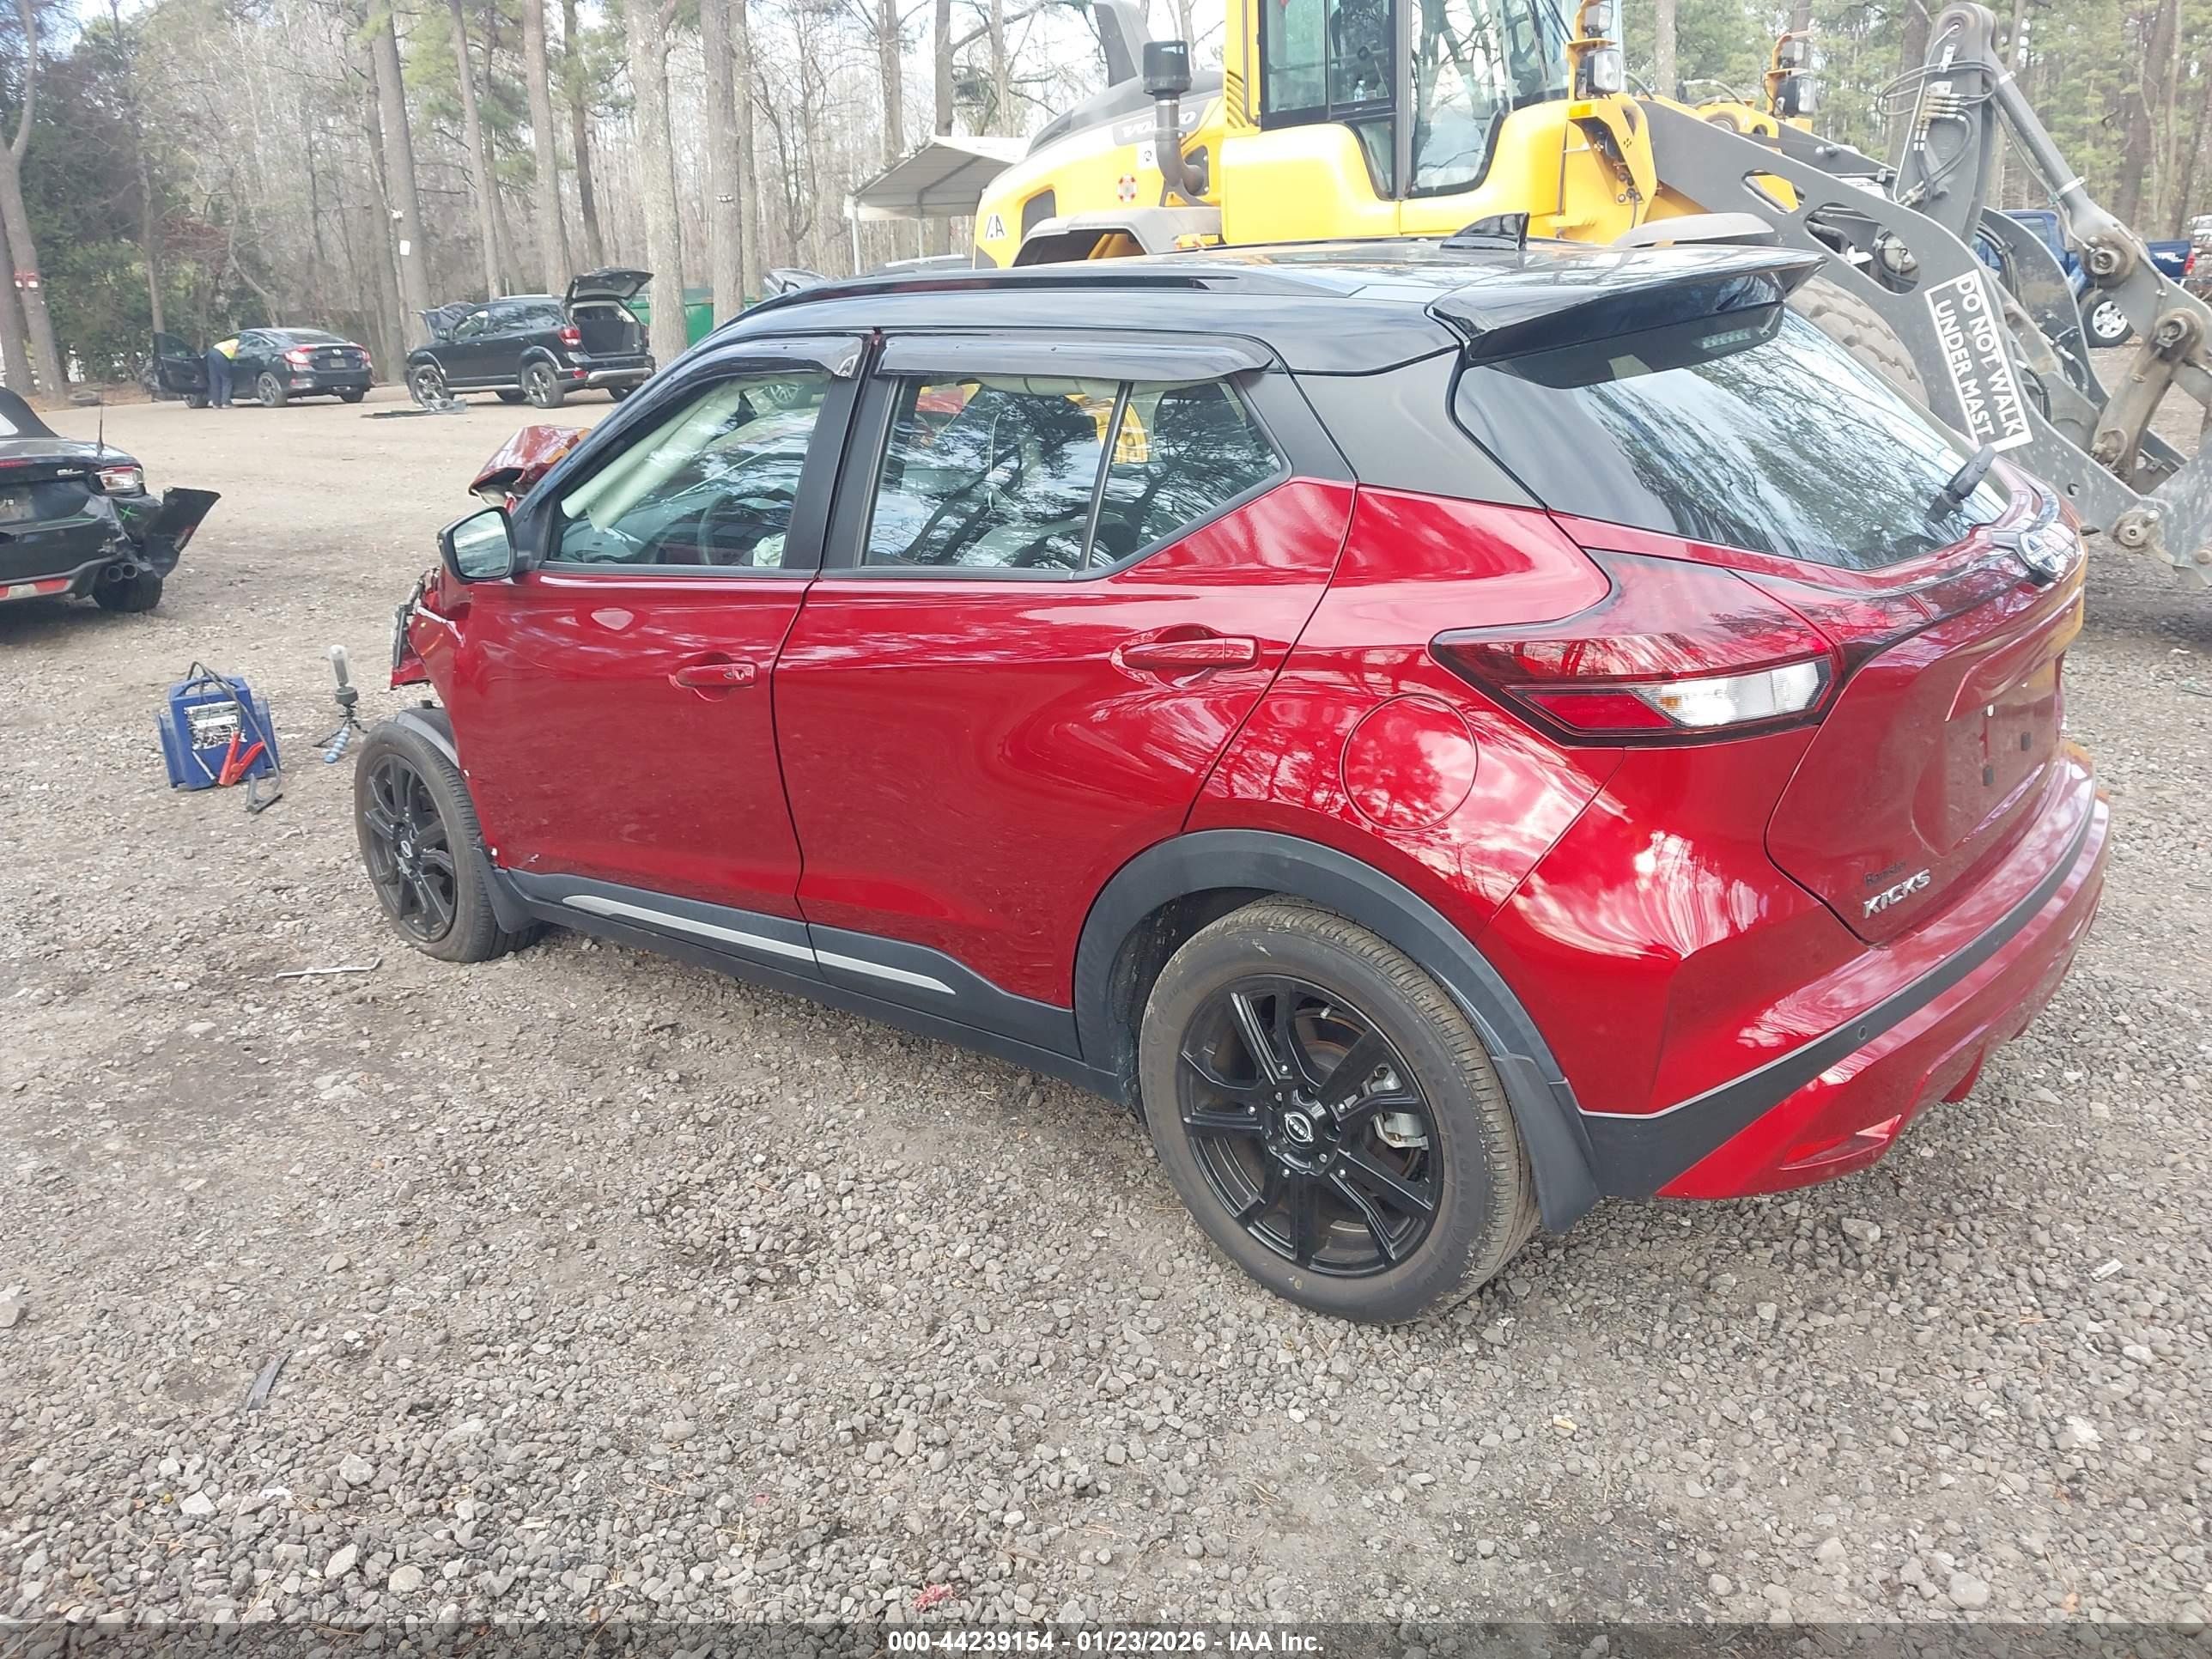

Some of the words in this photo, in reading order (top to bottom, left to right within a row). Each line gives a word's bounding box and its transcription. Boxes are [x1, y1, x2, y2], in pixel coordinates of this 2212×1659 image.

[1121, 110, 1197, 138] VOO
[1956, 276, 1982, 313] DO
[1935, 299, 1973, 378] UNDER
[1960, 378, 1996, 436] MAST
[1968, 315, 2002, 370] NOT
[1987, 369, 2023, 437] WALK
[1862, 867, 1932, 920] KICKS
